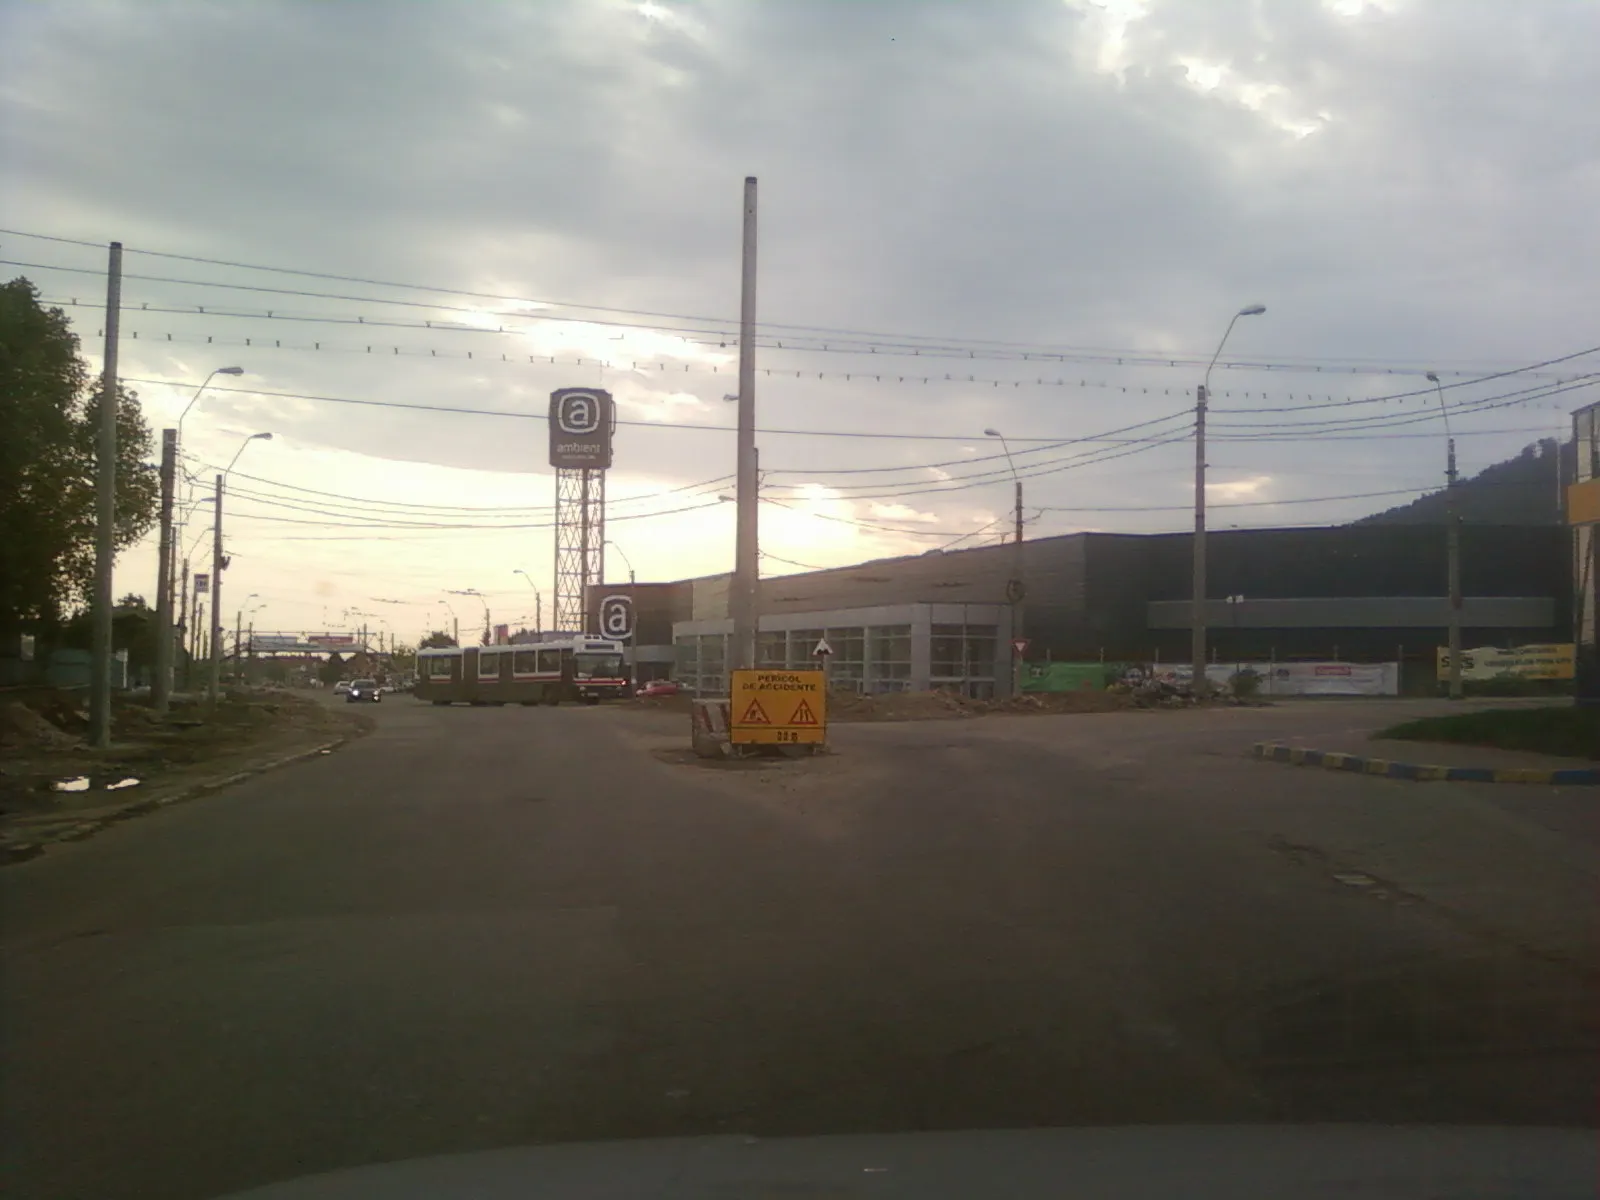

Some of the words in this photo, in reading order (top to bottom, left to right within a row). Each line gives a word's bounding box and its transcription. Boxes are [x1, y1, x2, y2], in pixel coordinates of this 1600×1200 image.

[557, 443, 601, 453] ambient
[757, 674, 801, 683] PERICOL
[742, 683, 756, 691] DE
[759, 683, 816, 692] ACCIDENTE
